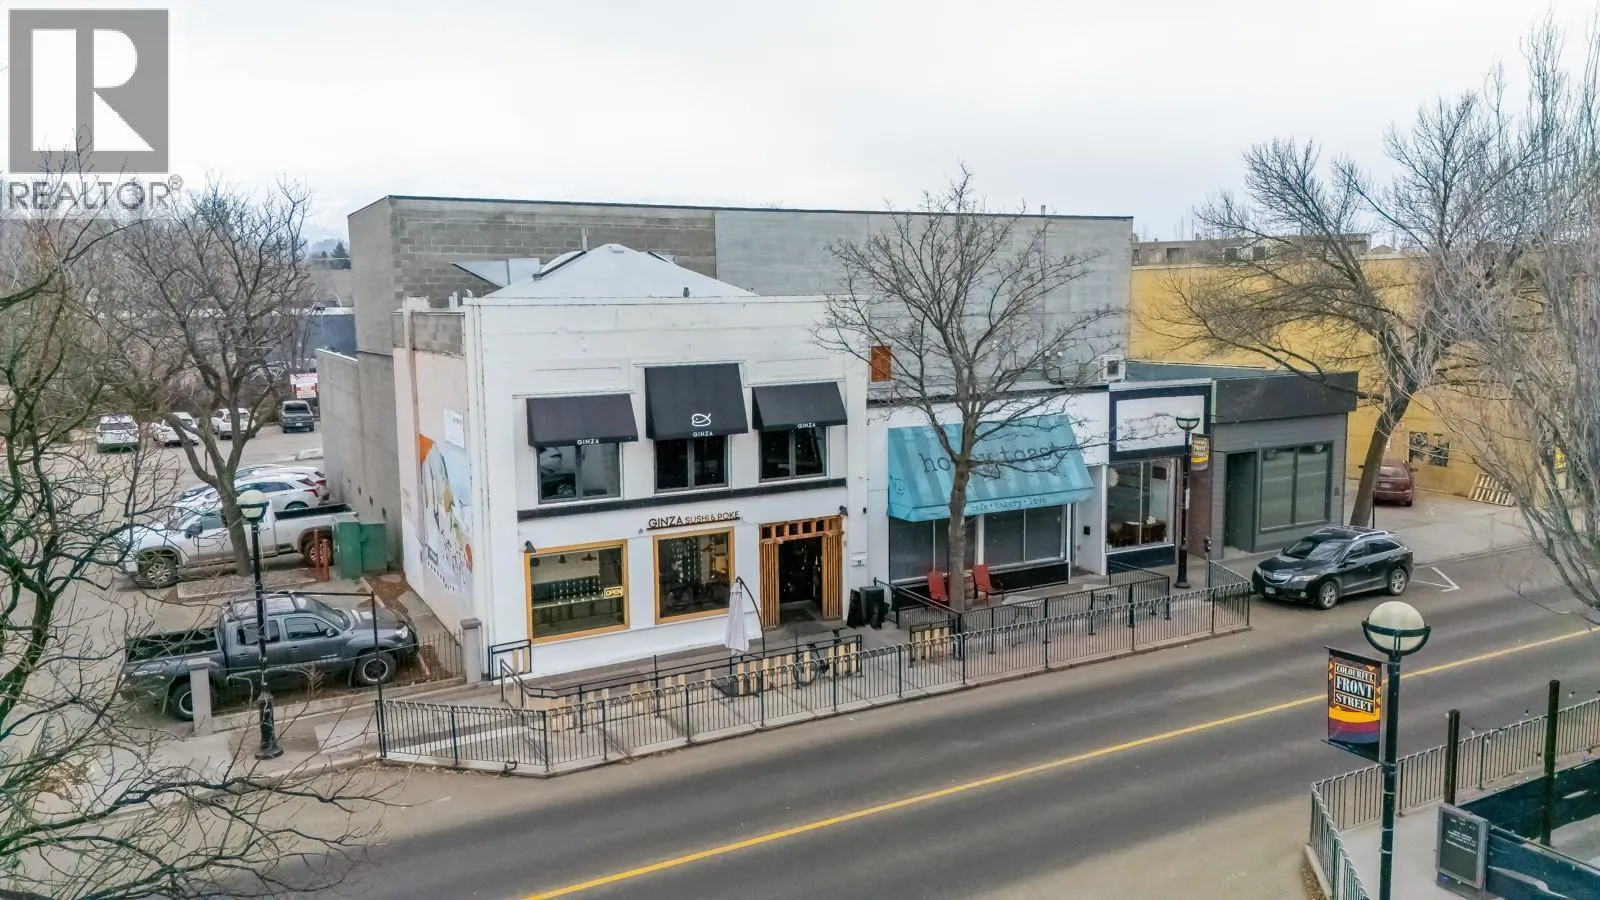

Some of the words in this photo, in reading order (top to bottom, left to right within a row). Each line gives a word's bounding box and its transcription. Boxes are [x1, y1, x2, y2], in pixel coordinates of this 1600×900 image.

[577, 438, 600, 446] GINZA
[692, 430, 714, 438] GINZA
[648, 515, 683, 528] GINZA
[684, 513, 709, 524] SUSHI
[1336, 665, 1374, 682] COLOURFUL
[1335, 676, 1374, 698] FRONT
[1335, 692, 1374, 712] STREET
